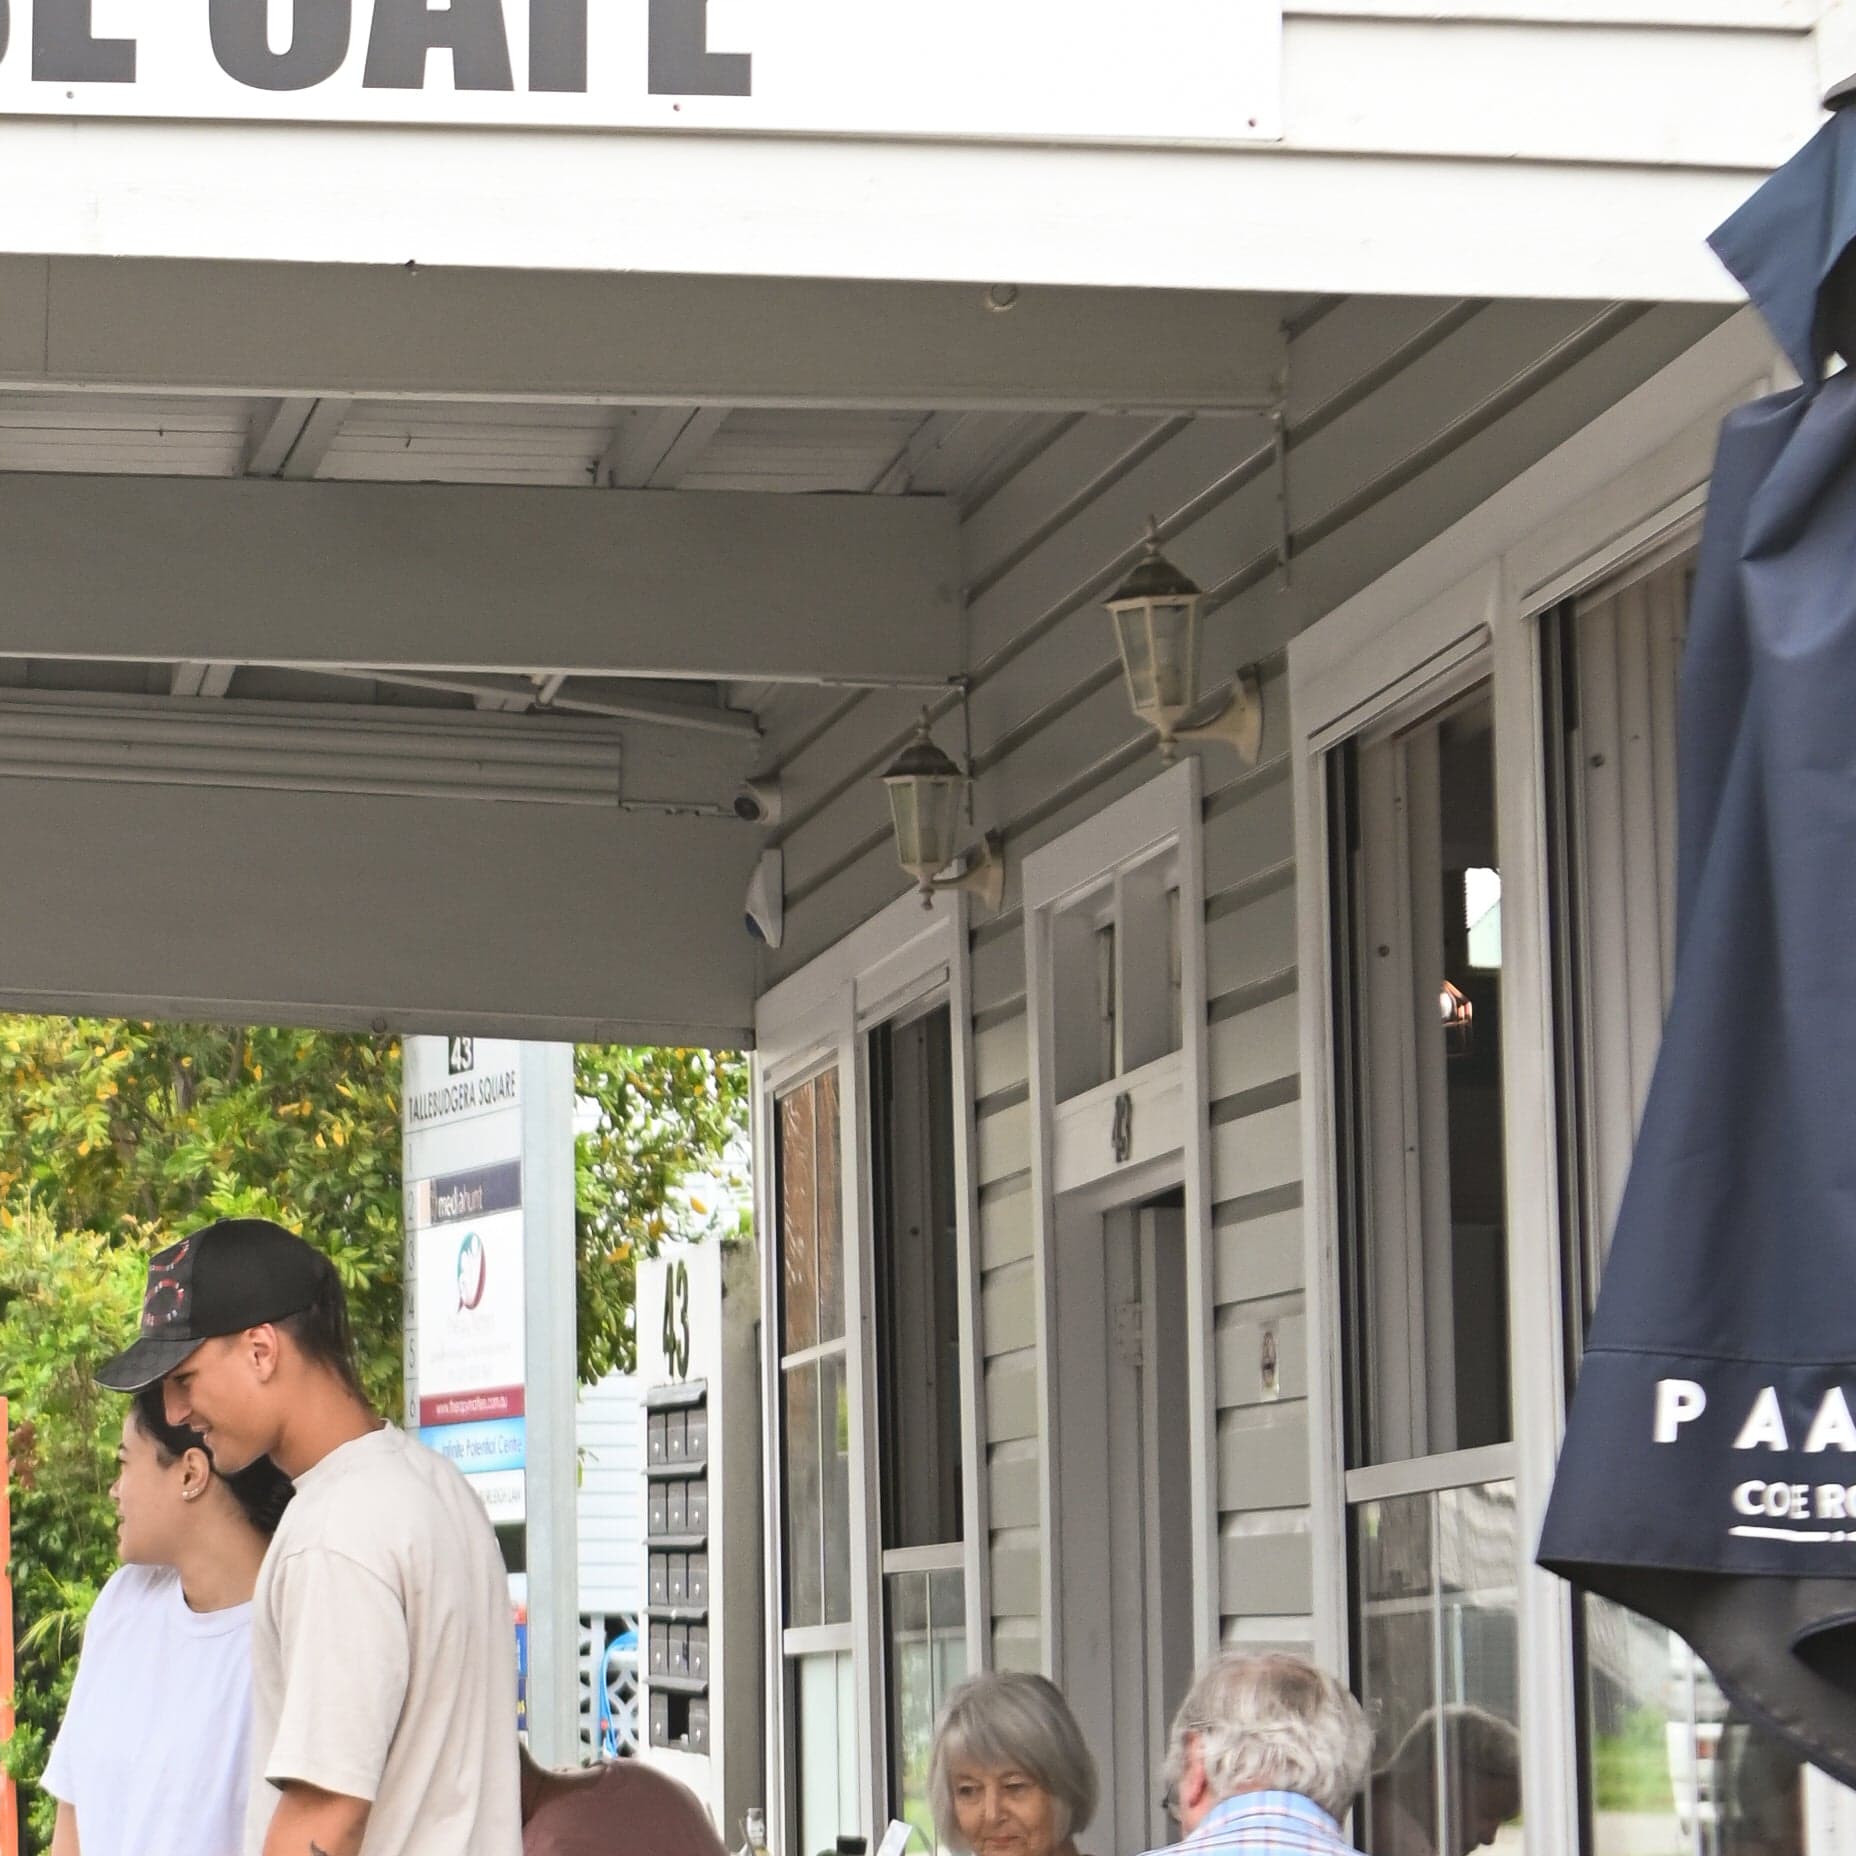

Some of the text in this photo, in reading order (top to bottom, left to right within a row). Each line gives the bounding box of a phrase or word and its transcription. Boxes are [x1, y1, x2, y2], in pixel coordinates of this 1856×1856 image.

[450, 1037, 473, 1072] 43
[409, 1069, 516, 1123] TALLEBUDGERA SQUARE
[662, 1258, 690, 1379] 43
